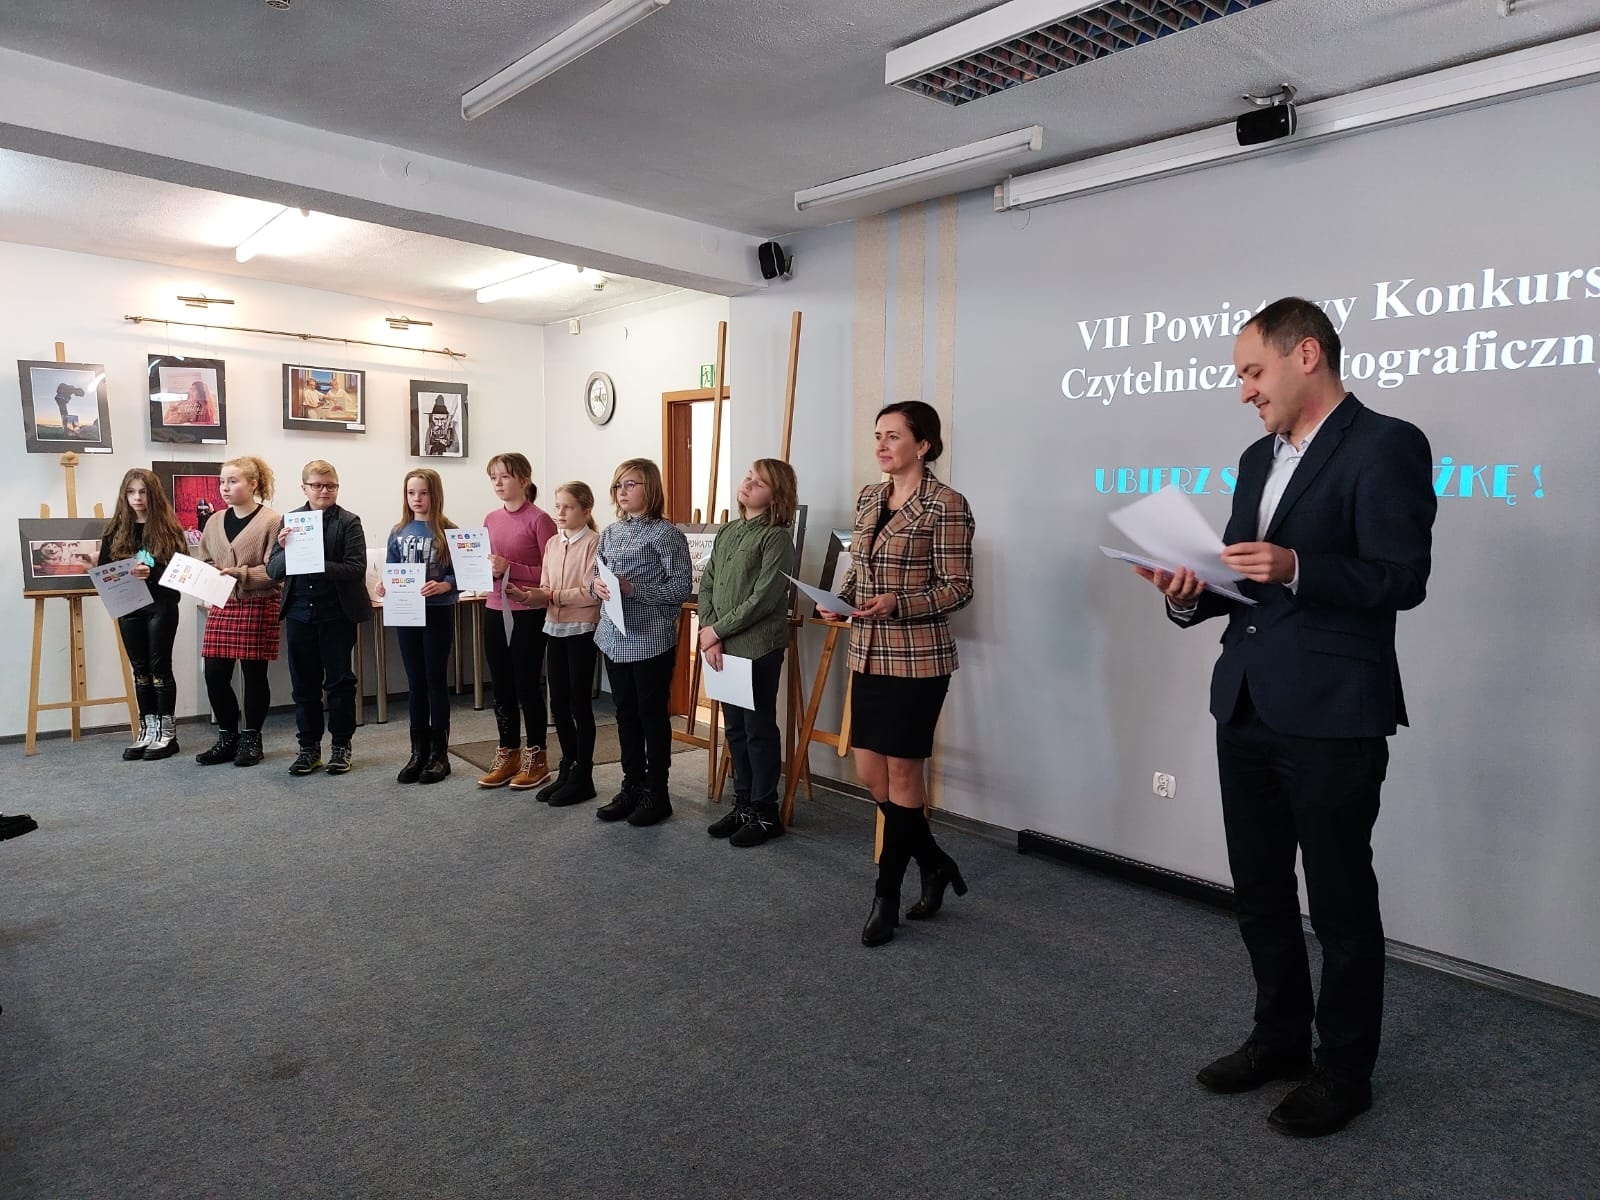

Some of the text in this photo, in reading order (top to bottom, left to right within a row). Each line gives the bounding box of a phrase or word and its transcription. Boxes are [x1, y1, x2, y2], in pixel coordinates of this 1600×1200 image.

[1077, 314, 1132, 351] VII
[1371, 266, 1600, 321] Konkurs
[1095, 466, 1211, 495] UBIERZ
[1533, 464, 1544, 498] !
